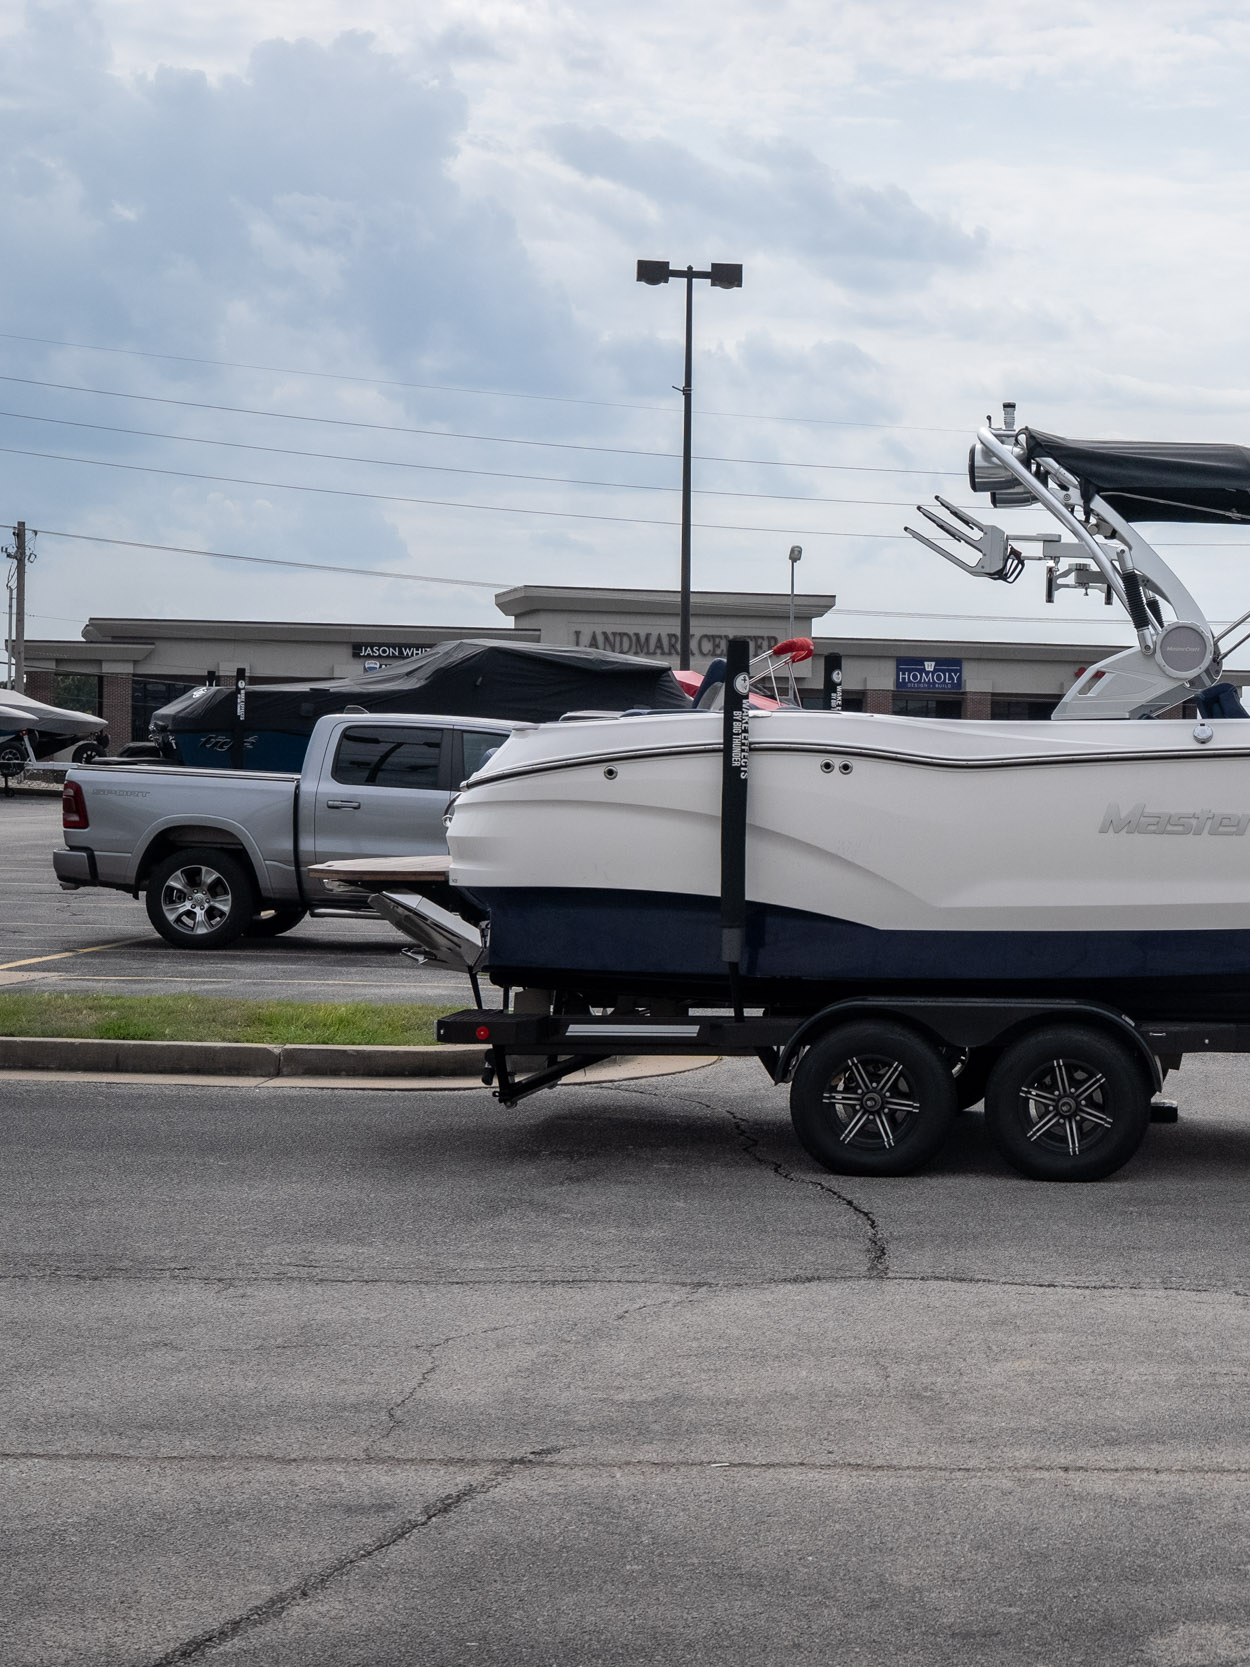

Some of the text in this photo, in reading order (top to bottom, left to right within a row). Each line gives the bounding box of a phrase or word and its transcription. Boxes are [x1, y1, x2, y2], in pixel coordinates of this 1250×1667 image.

[359, 646, 399, 656] JASON
[899, 671, 960, 683] HOMOLY
[731, 711, 742, 767] BY BIG THUNDER
[740, 699, 750, 779] WAKE EFFECTS
[92, 788, 151, 798] SPORT
